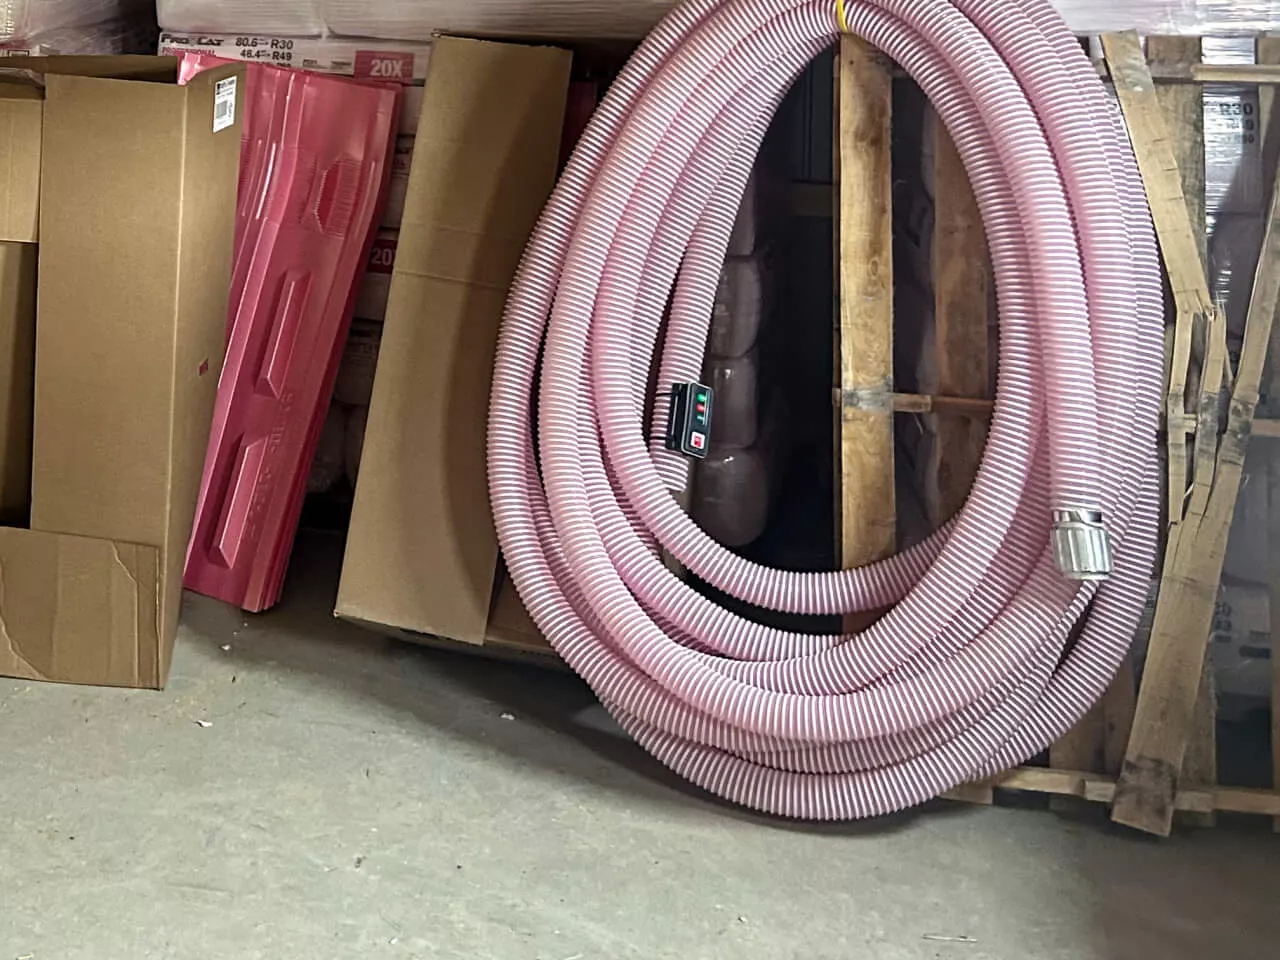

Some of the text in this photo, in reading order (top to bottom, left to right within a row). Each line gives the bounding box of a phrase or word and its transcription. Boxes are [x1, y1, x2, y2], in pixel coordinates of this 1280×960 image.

[236, 38, 293, 49] 80.6 R30
[240, 50, 292, 60] 46.4 R49
[370, 59, 403, 77] 20X
[371, 248, 396, 265] 20
